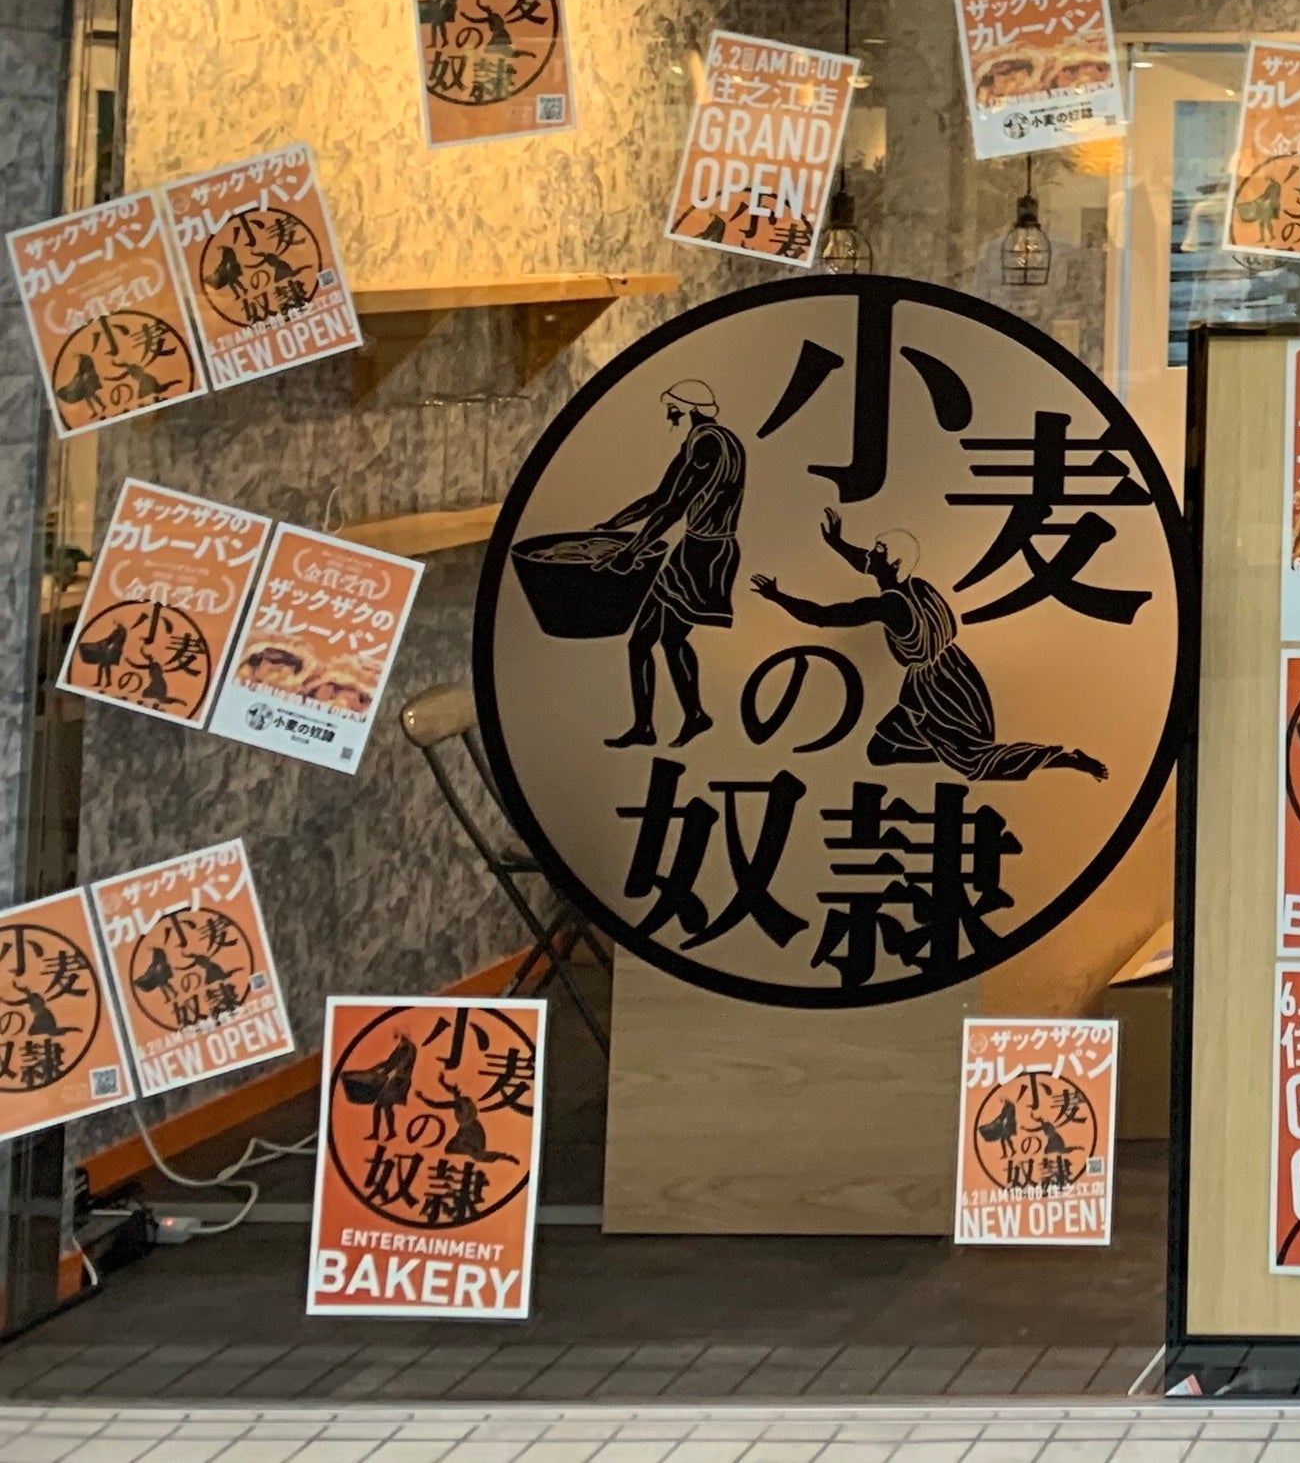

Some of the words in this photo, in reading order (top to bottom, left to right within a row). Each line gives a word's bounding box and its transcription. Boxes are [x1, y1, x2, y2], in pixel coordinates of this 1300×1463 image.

[969, 10, 1101, 51] カレーパン
[707, 70, 838, 118] 住之江店
[698, 106, 833, 165] GRAND
[191, 152, 305, 206] ザックザクの
[690, 156, 824, 223] OPEN!
[25, 201, 139, 260] ザックザクの
[175, 171, 314, 246] カレーパン
[22, 218, 159, 299] カレーパン
[215, 338, 274, 384] NEW
[281, 304, 356, 360] OPEN!
[109, 520, 262, 568] カレーパン
[131, 496, 251, 536] ザックザクの
[256, 602, 388, 660] カレーパン
[268, 576, 394, 632] ザックザクの
[118, 671, 143, 693] の
[740, 644, 865, 755] の
[122, 850, 237, 904] ザックザクの
[615, 756, 1024, 988] 奴隷
[104, 868, 249, 947] カレーパン
[142, 1038, 205, 1090] NEW
[206, 1010, 286, 1066] OPEN!
[990, 1025, 1113, 1053] ザックザクの
[966, 1048, 1115, 1089] カレーパン
[404, 1113, 446, 1150] の
[1020, 1135, 1042, 1156] の
[362, 1145, 491, 1225] 奴隷
[339, 1227, 505, 1262] ENTERTAINMENT
[961, 1204, 1022, 1238] NEW
[1028, 1196, 1107, 1237] OPEN!
[315, 1247, 522, 1311] BAKERY
